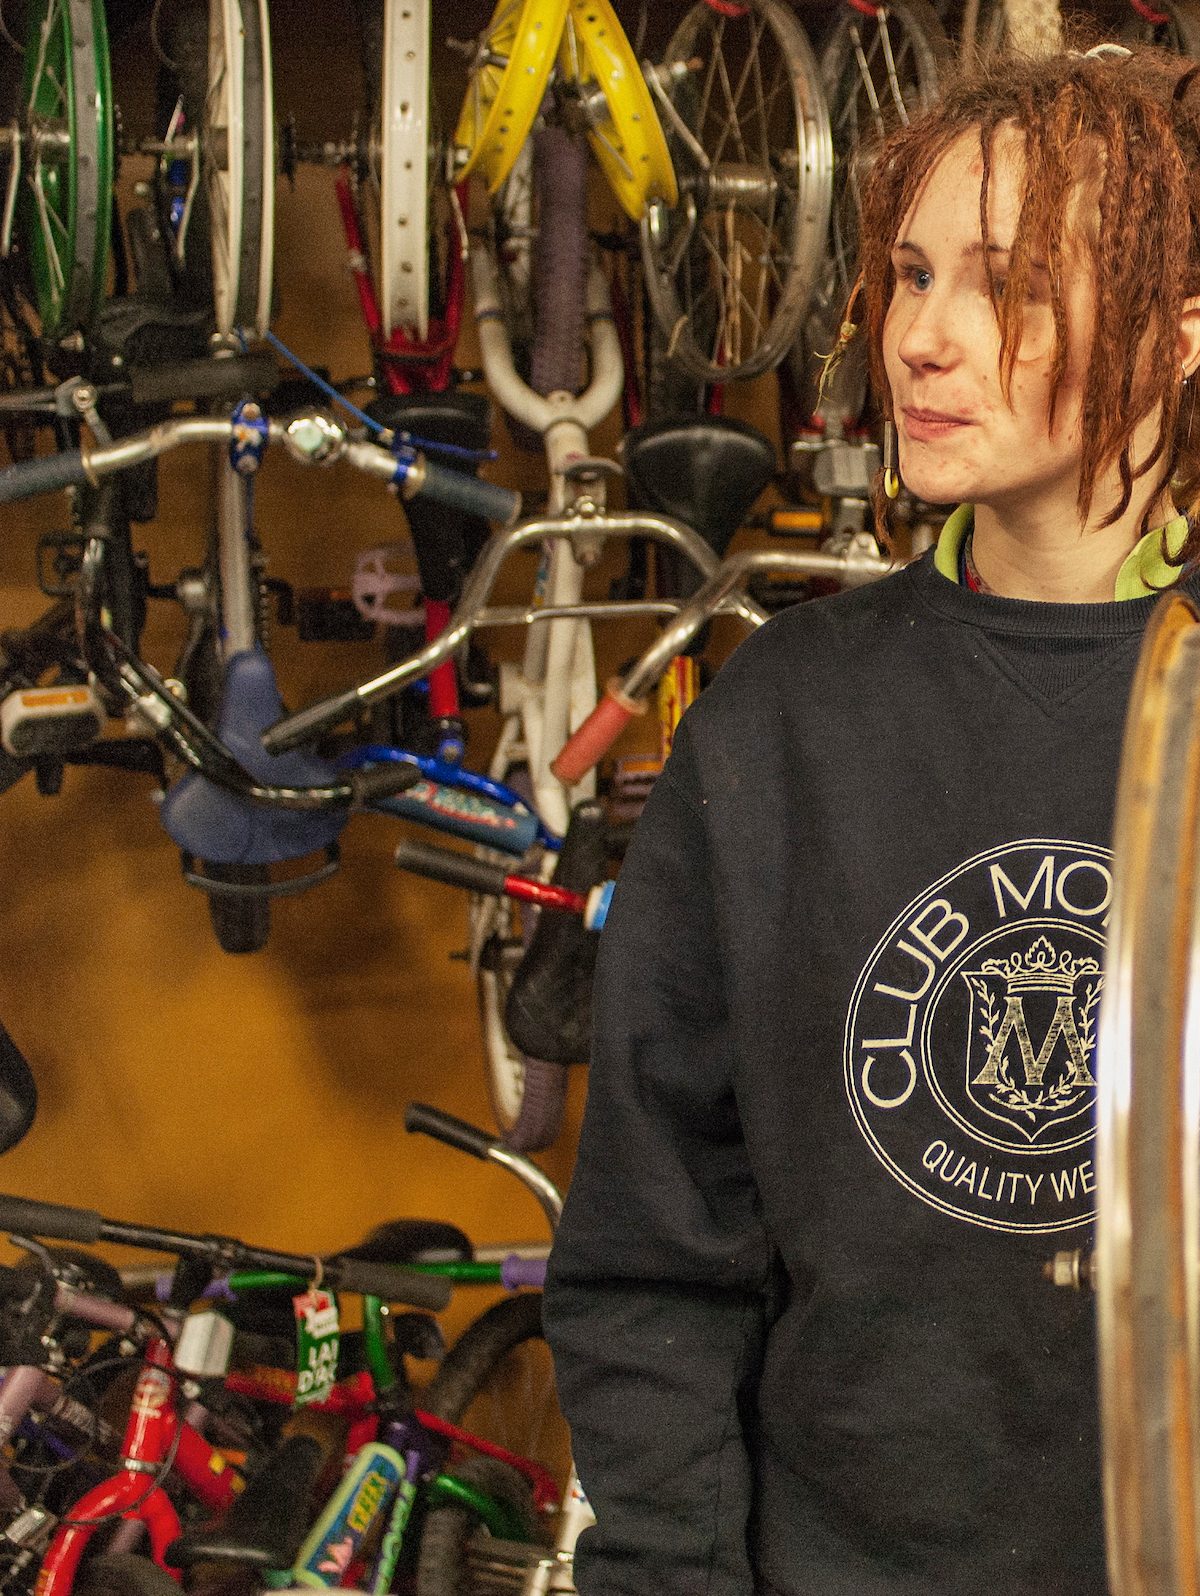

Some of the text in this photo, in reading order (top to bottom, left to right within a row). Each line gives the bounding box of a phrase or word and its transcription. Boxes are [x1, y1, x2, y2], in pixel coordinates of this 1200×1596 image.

[861, 855, 1114, 1110] CLUB MO
[921, 1139, 1099, 1205] QUALITY WE
